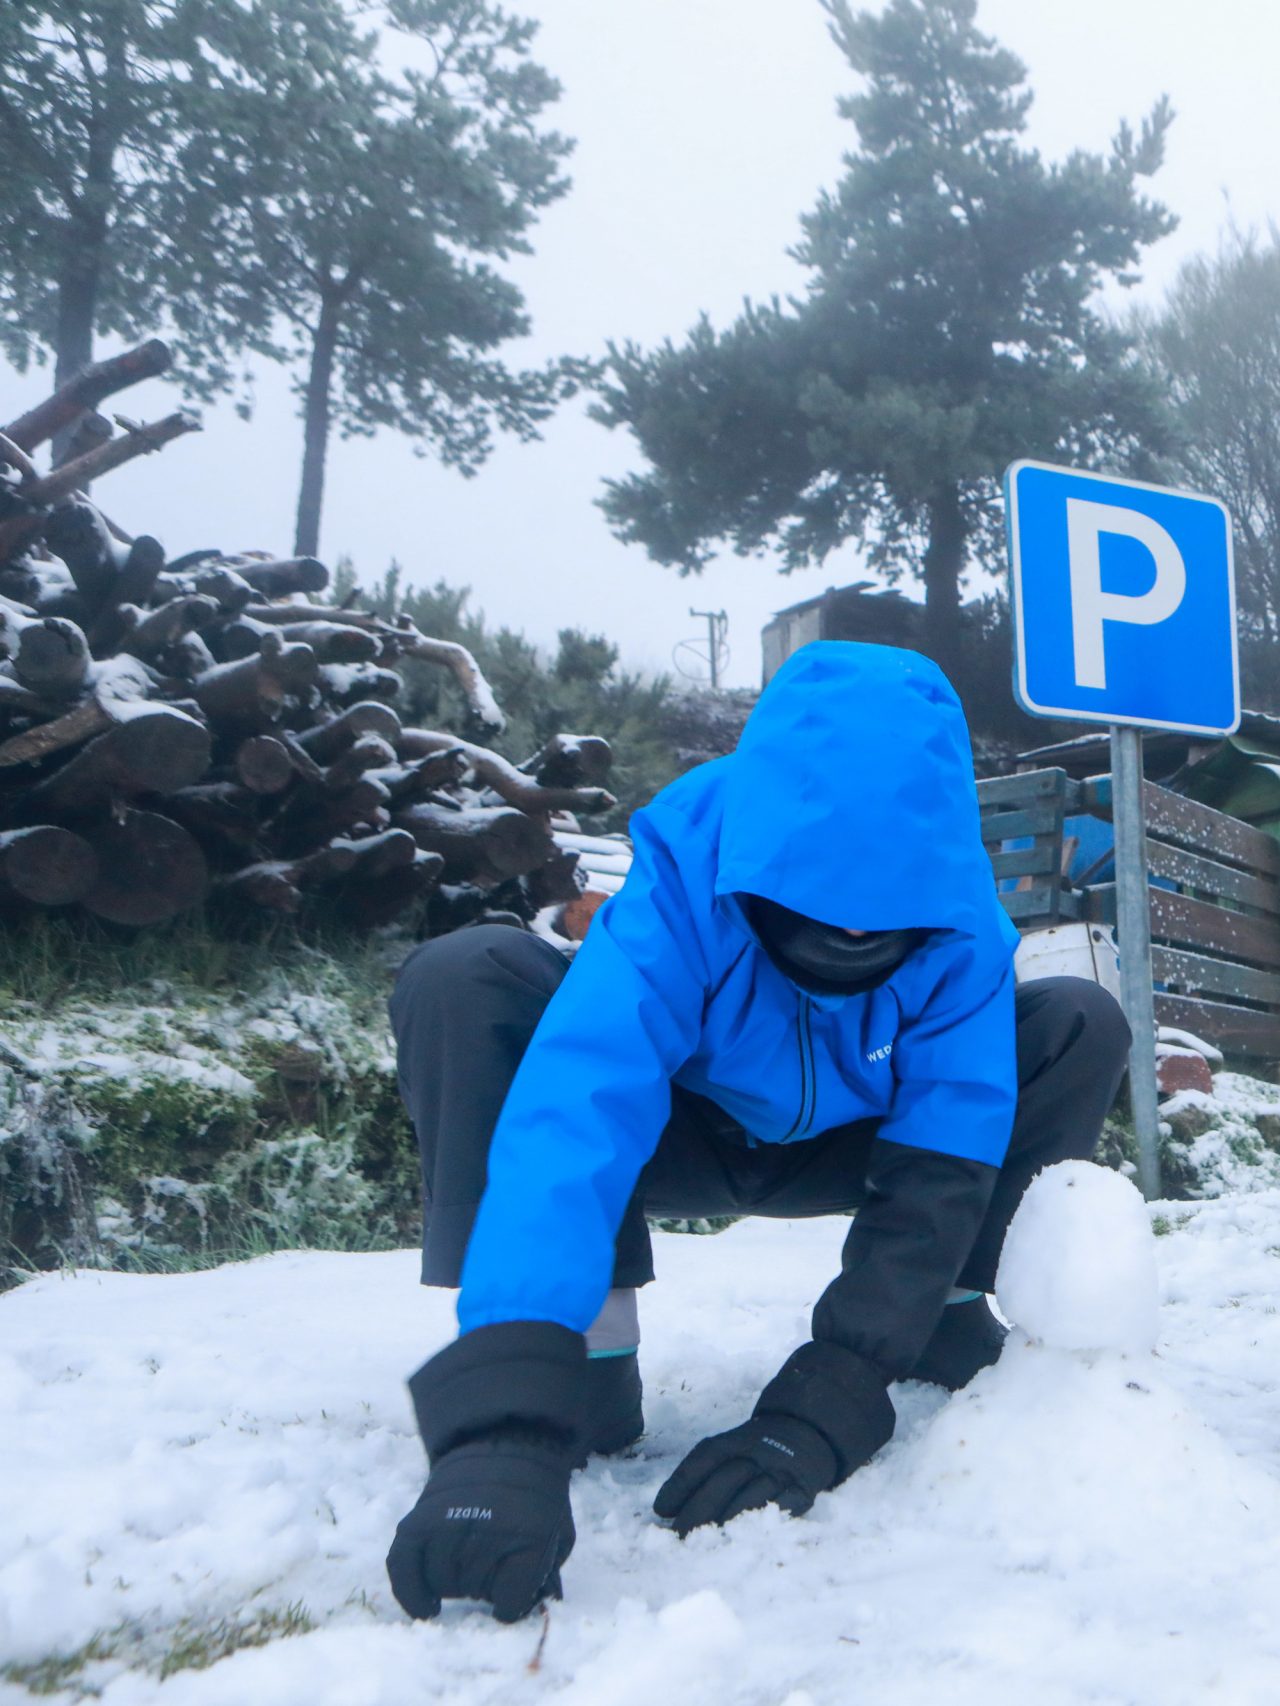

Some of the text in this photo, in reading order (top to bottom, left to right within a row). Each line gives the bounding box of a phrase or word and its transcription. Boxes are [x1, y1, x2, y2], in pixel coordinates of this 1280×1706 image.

[1066, 497, 1187, 690] P
[866, 1041, 893, 1063] WED
[446, 1507, 492, 1519] WEDZE
